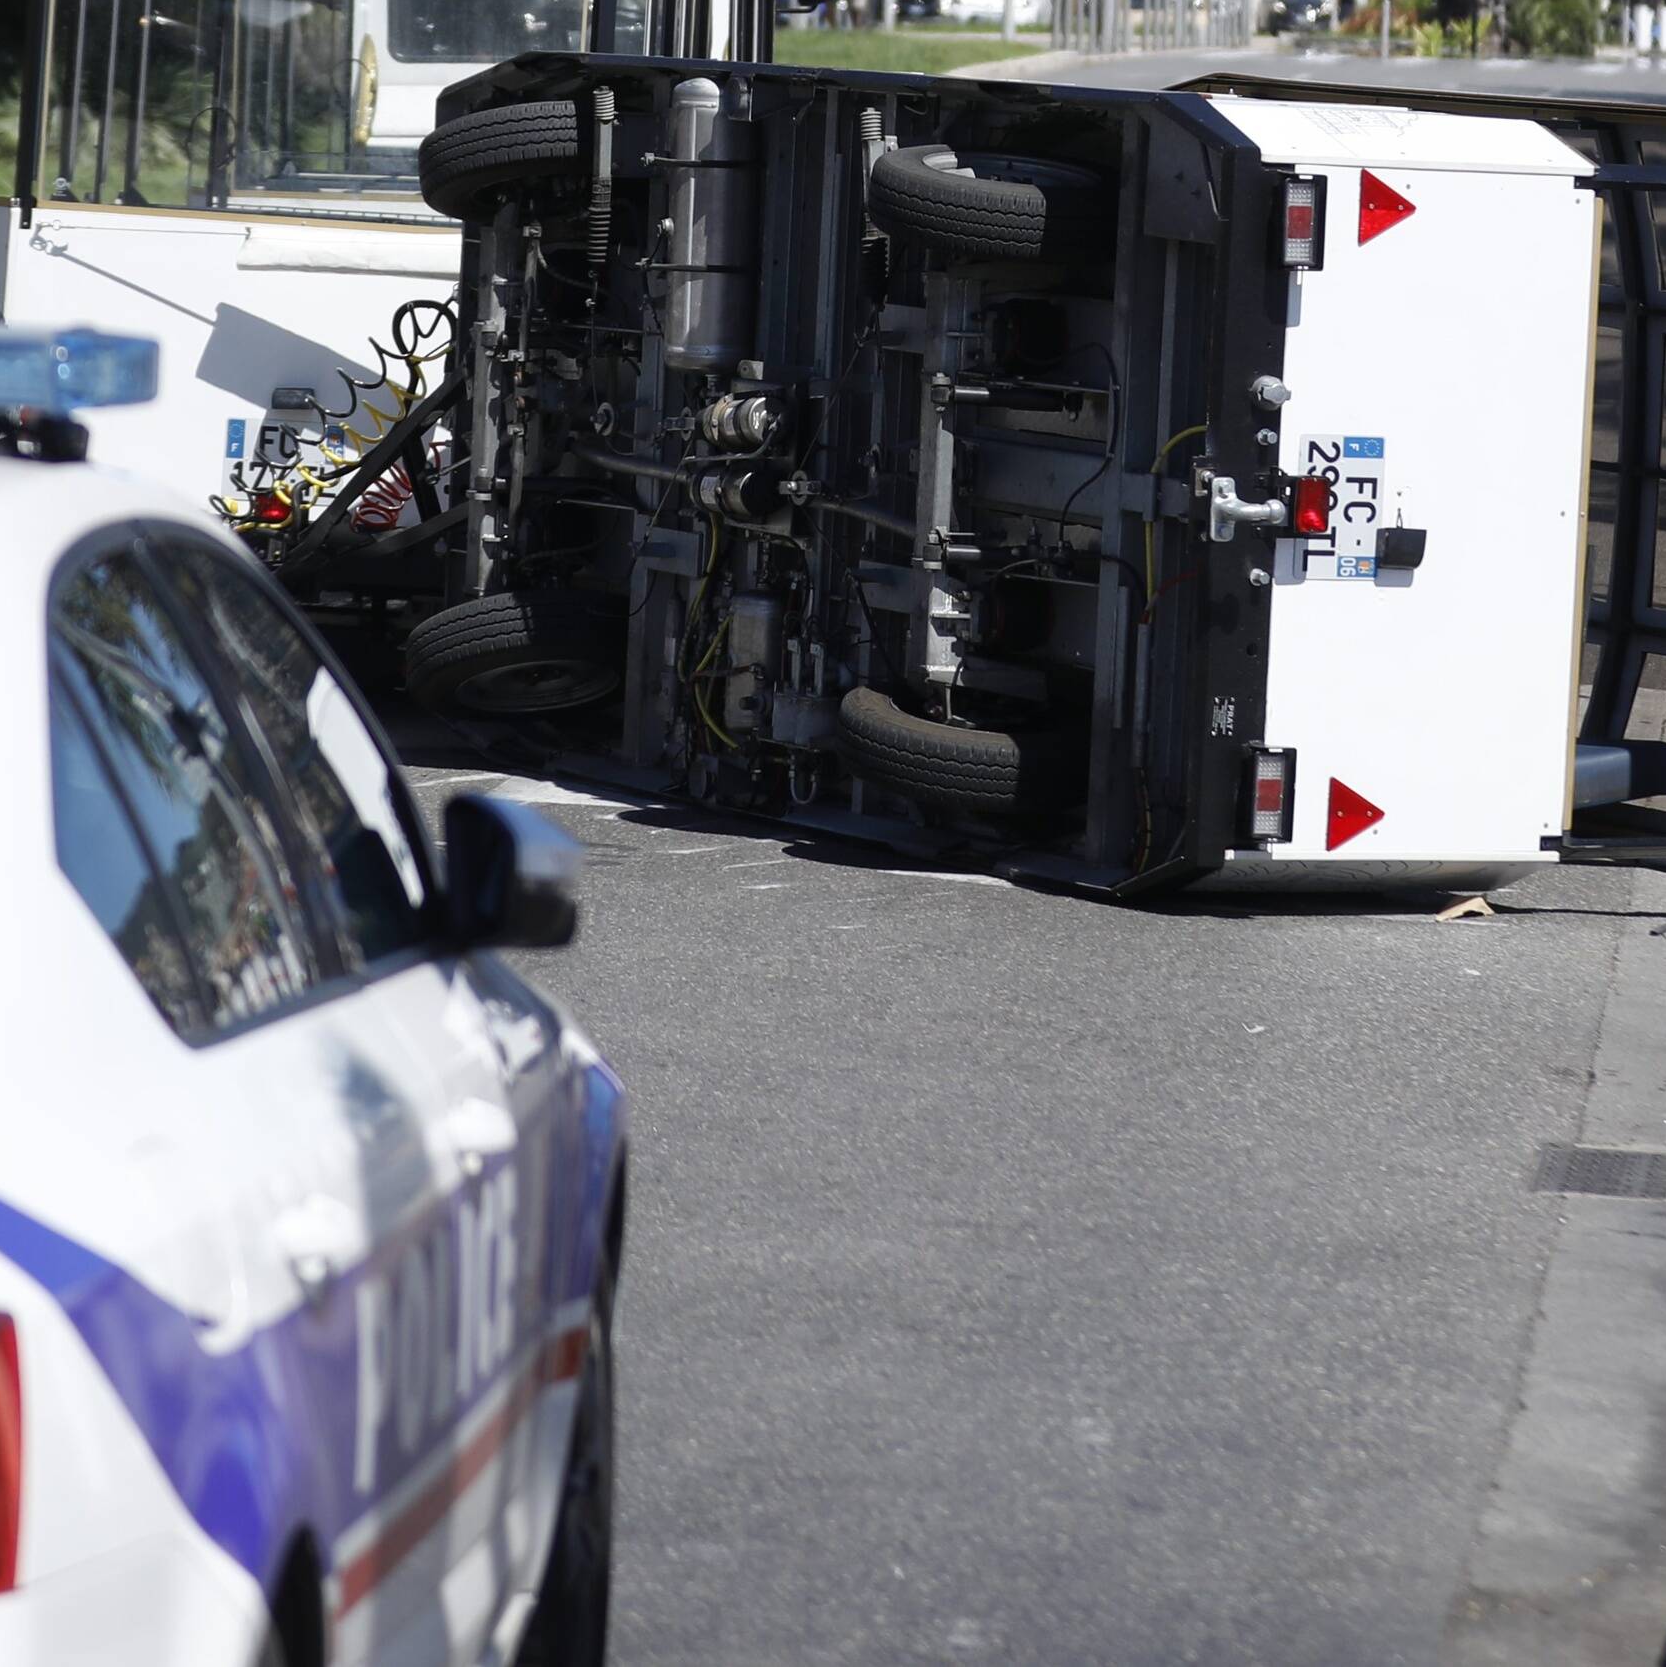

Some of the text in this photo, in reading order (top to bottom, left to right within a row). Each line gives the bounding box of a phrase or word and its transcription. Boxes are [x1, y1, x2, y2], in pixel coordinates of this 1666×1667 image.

[231, 442, 239, 453] F
[1349, 443, 1360, 452] F
[1307, 441, 1340, 511] 29
[1343, 477, 1378, 523] FC
[1340, 557, 1357, 576] 06
